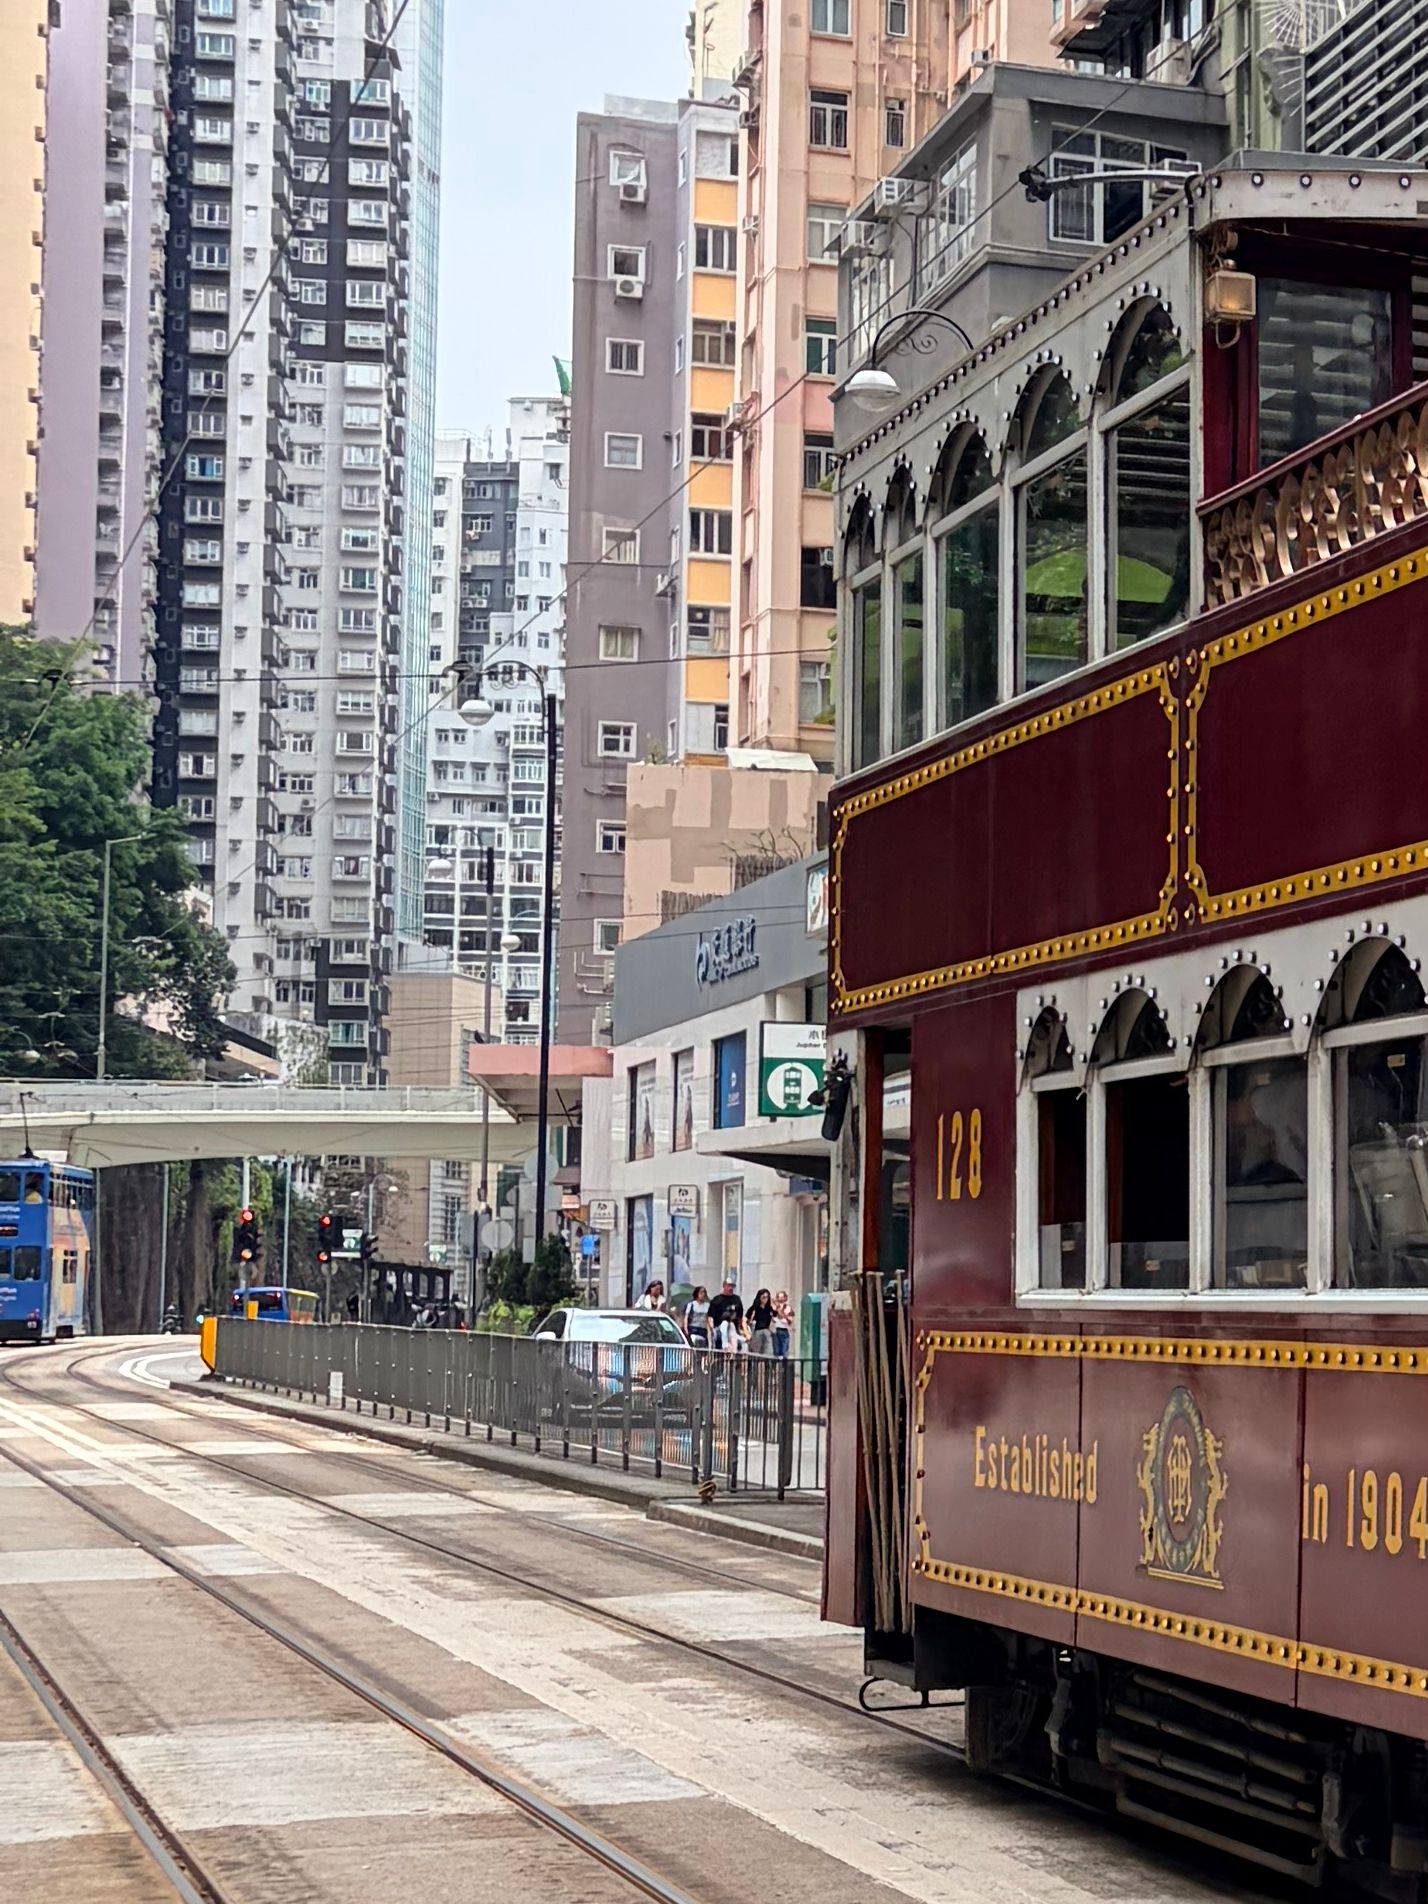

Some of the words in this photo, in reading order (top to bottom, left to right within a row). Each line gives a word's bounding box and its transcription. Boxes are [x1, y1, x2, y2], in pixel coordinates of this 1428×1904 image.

[936, 1107, 983, 1201] 128
[974, 1425, 1099, 1505] Established
[1302, 1461, 1329, 1545] in
